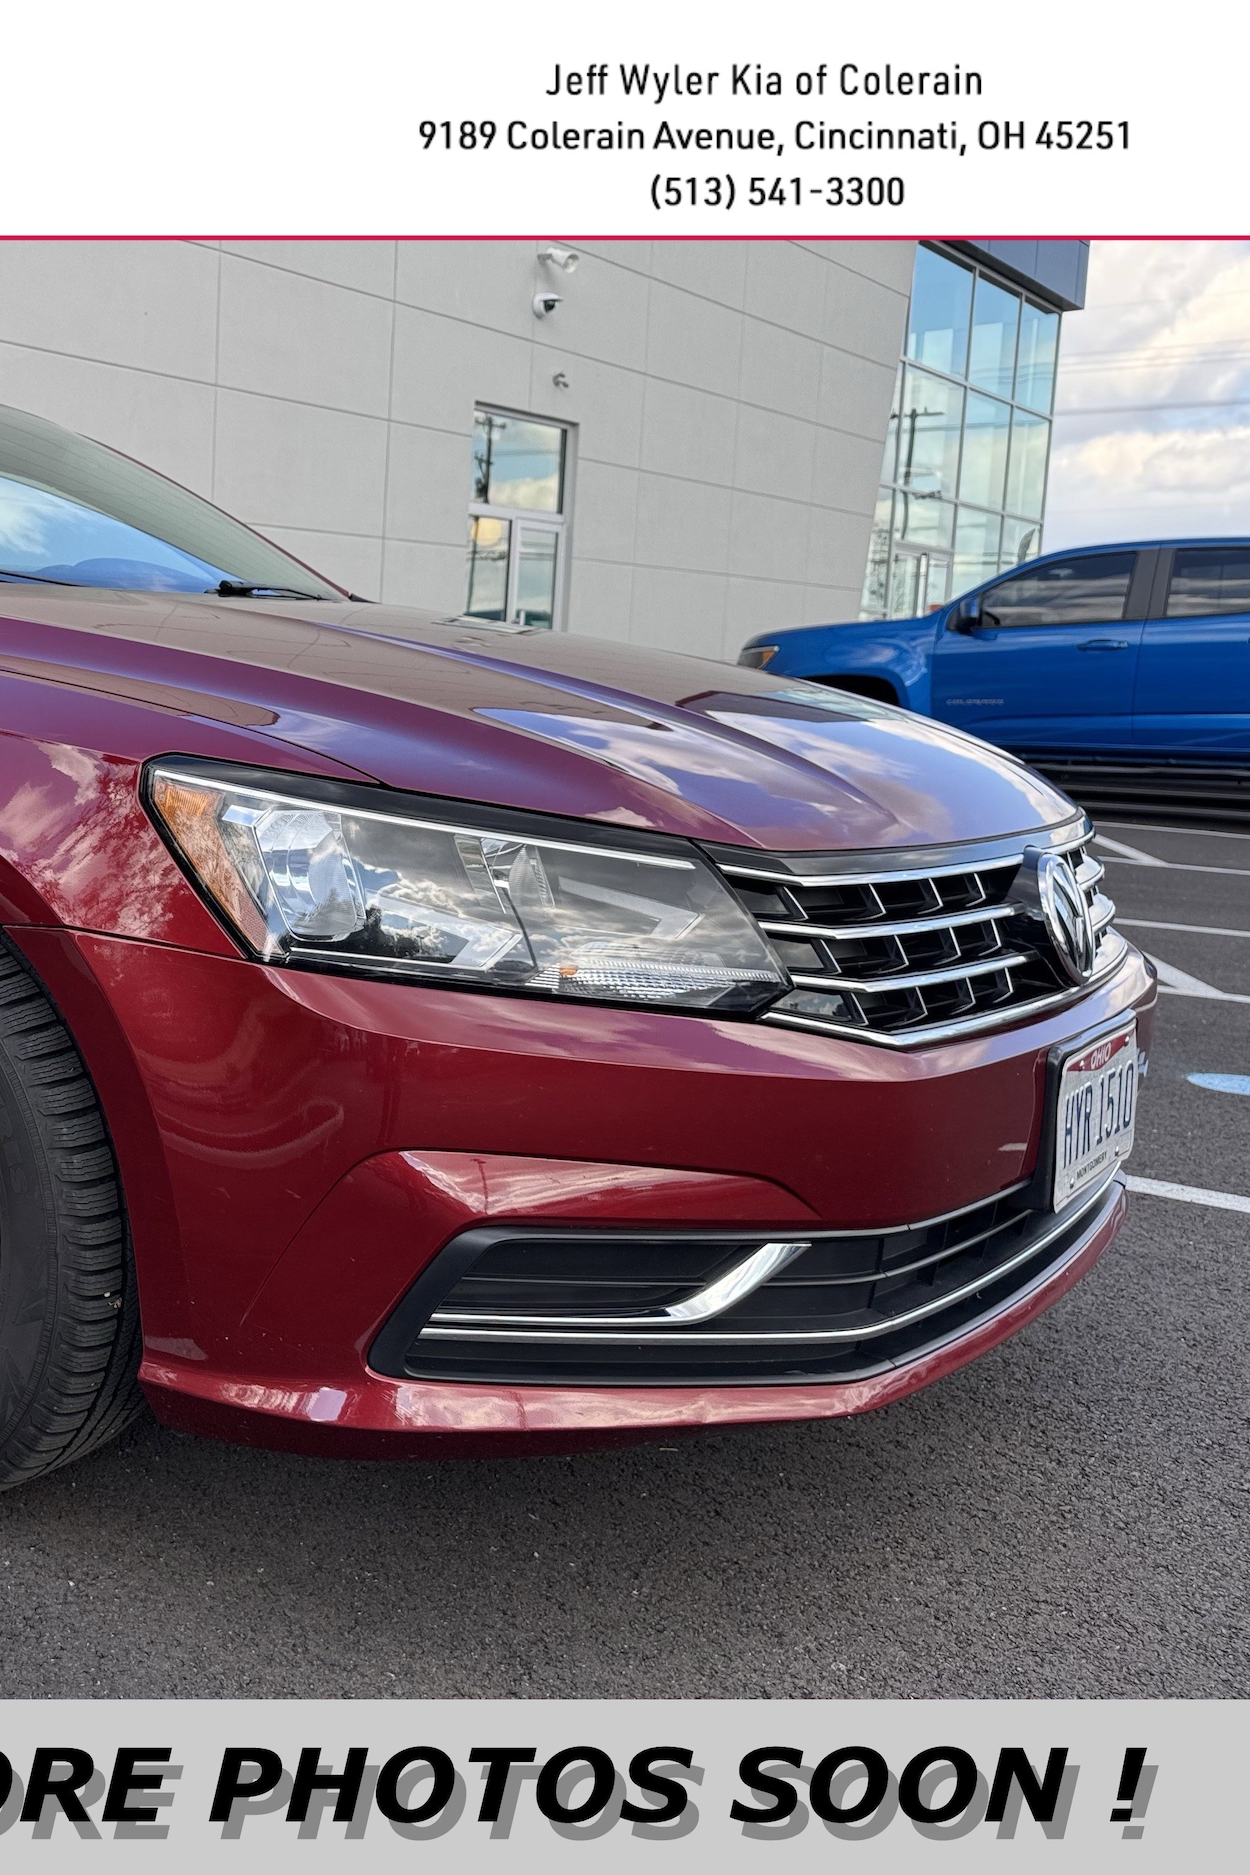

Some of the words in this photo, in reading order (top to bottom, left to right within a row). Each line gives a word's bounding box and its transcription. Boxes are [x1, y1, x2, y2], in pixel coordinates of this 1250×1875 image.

[1090, 1042, 1112, 1070] OHIO
[1063, 1081, 1093, 1170] HYR
[1095, 1060, 1134, 1146] 1510
[1076, 1150, 1108, 1180] MONTGOMERY
